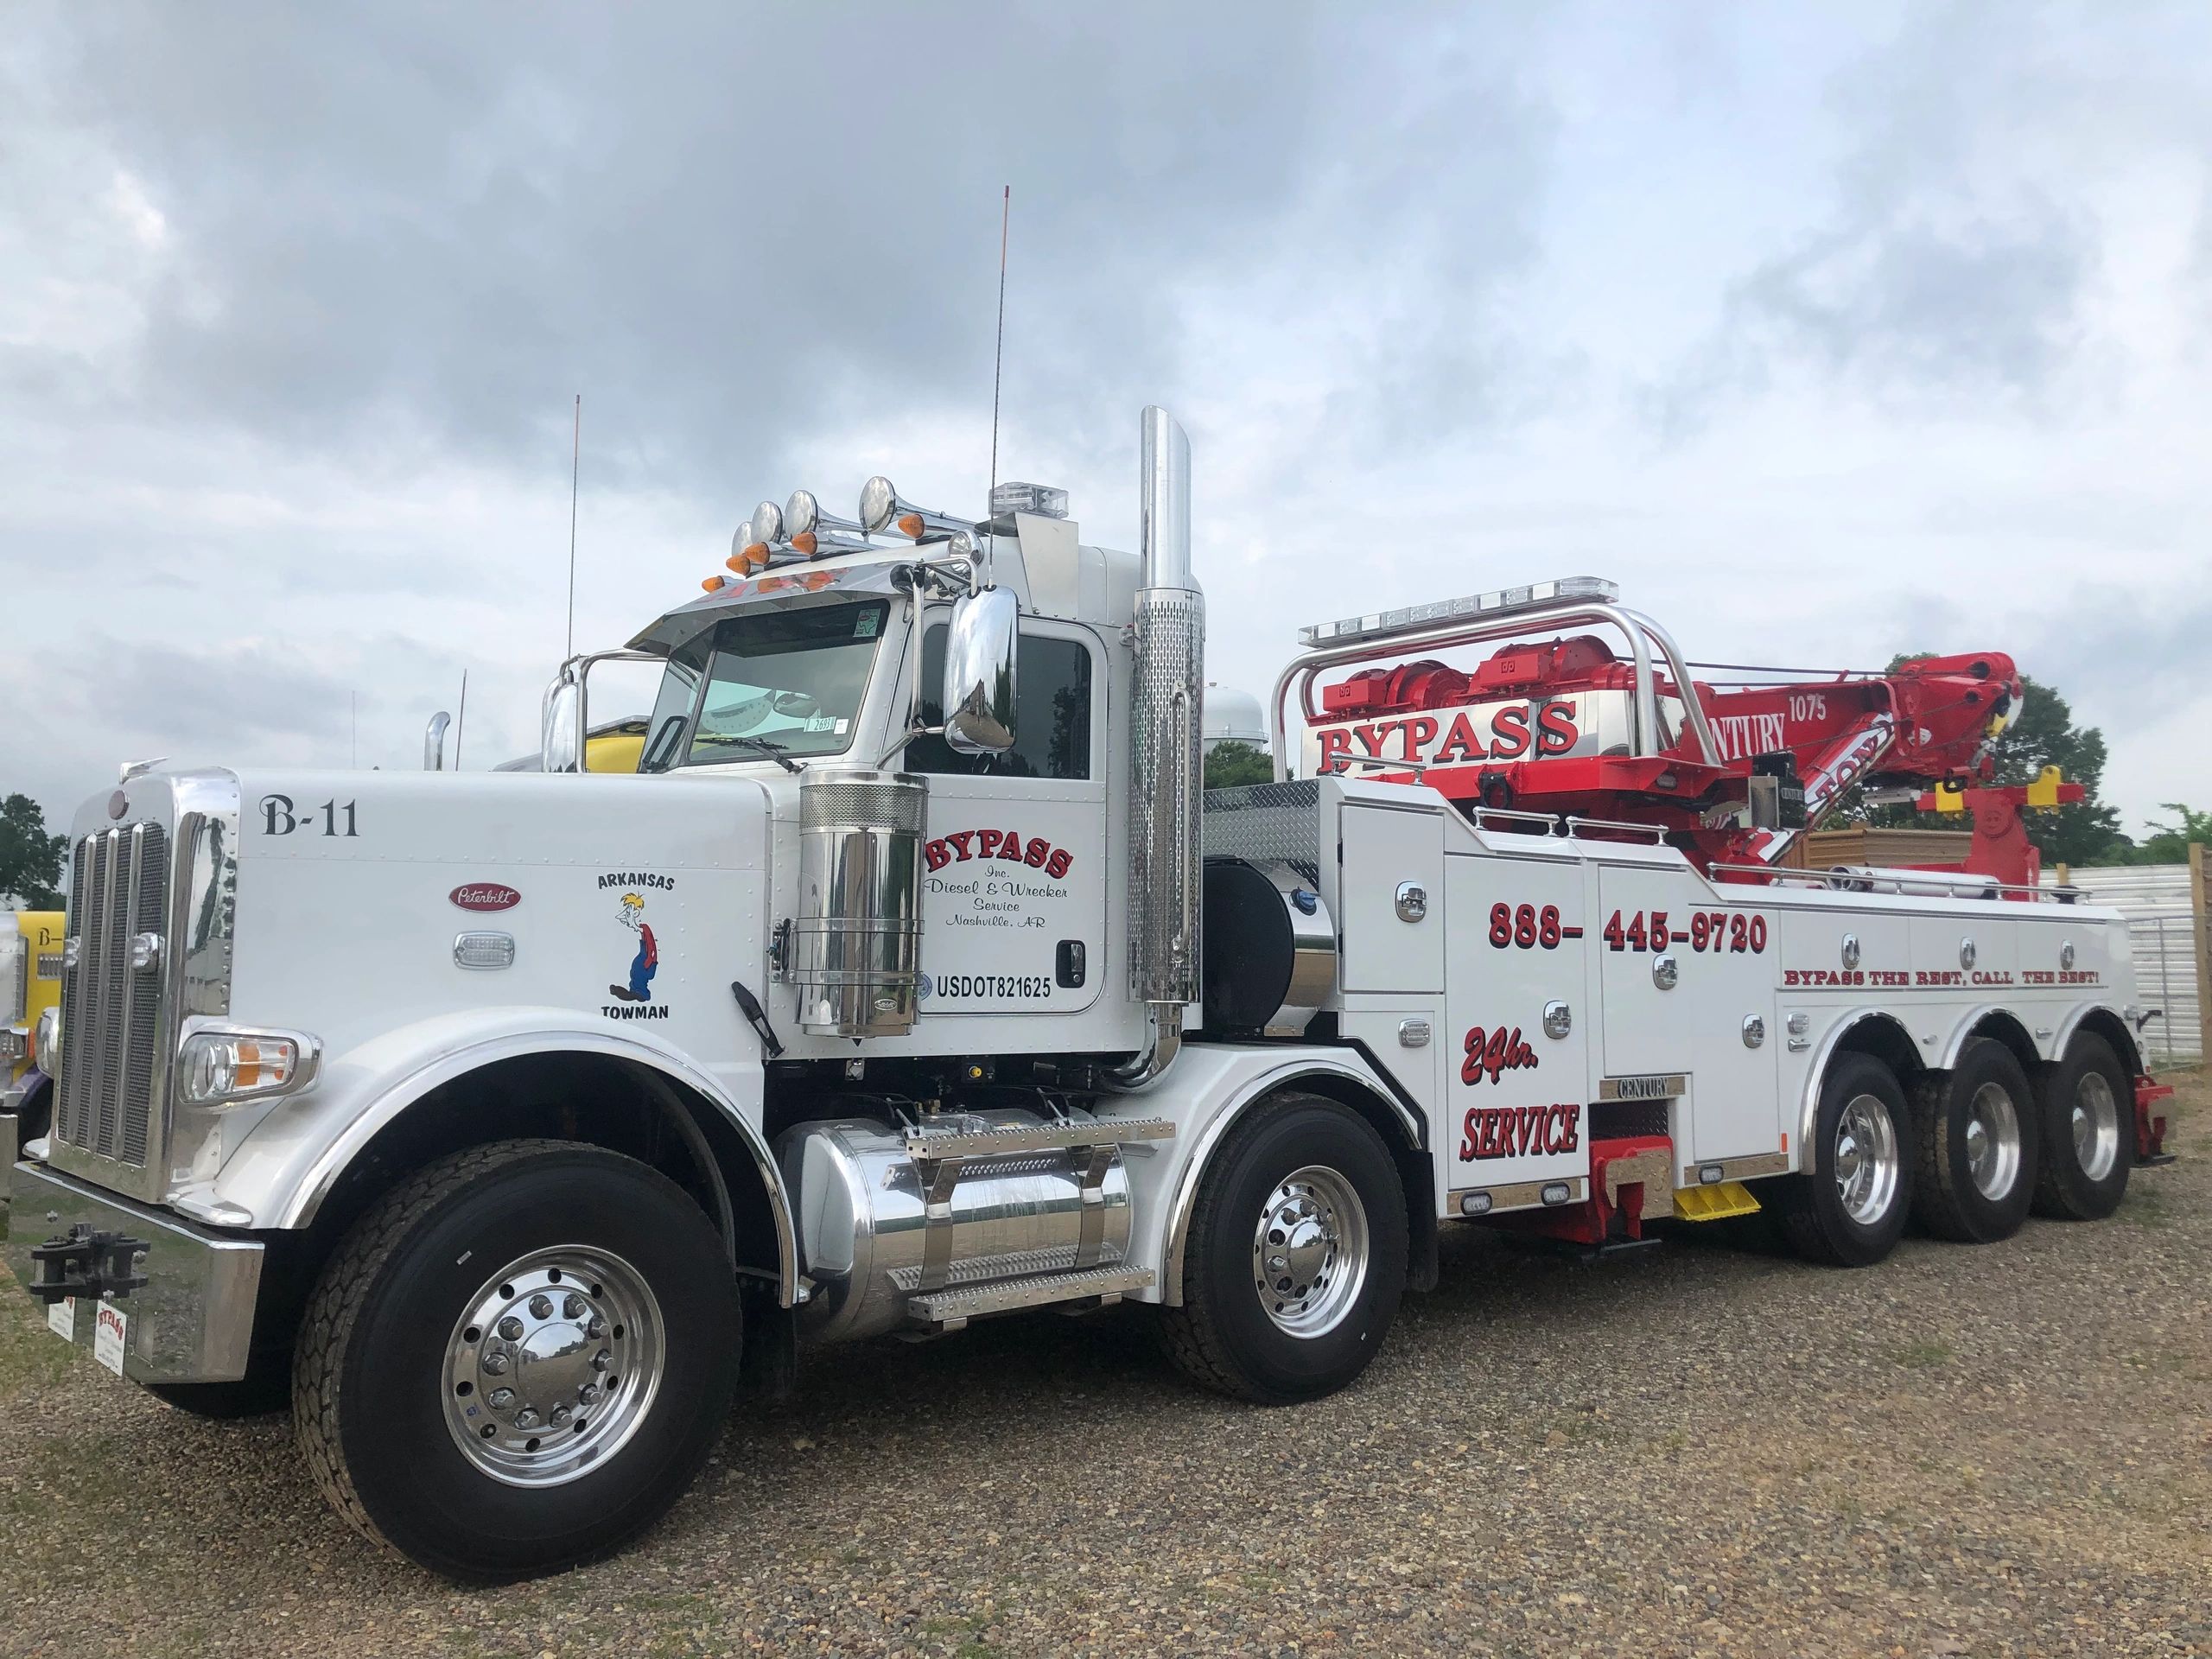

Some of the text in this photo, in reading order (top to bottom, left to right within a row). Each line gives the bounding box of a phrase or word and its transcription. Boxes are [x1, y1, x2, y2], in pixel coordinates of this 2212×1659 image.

[1789, 694, 1827, 721] 1075
[1316, 701, 1579, 776] BYPASS
[1708, 713, 1785, 761] NTURY
[259, 794, 360, 837] B-11
[925, 830, 1074, 880] BYPASS
[598, 872, 675, 891] ARKANSAS
[984, 865, 1010, 878] Inc.
[457, 887, 515, 904] Peterbilt
[924, 878, 1068, 898] Diesel & Wrecker
[973, 897, 1020, 912] Service
[1017, 916, 1046, 928] AR
[1604, 909, 1767, 954] 445-9720
[937, 976, 1052, 998] USDOT821625
[1783, 969, 2100, 987] BYPASS THE REST, CALL THE BEST!
[601, 1005, 669, 1020] TOWMAN
[1618, 1077, 1669, 1099] CENTURY
[1459, 1103, 1580, 1161] SERVICE
